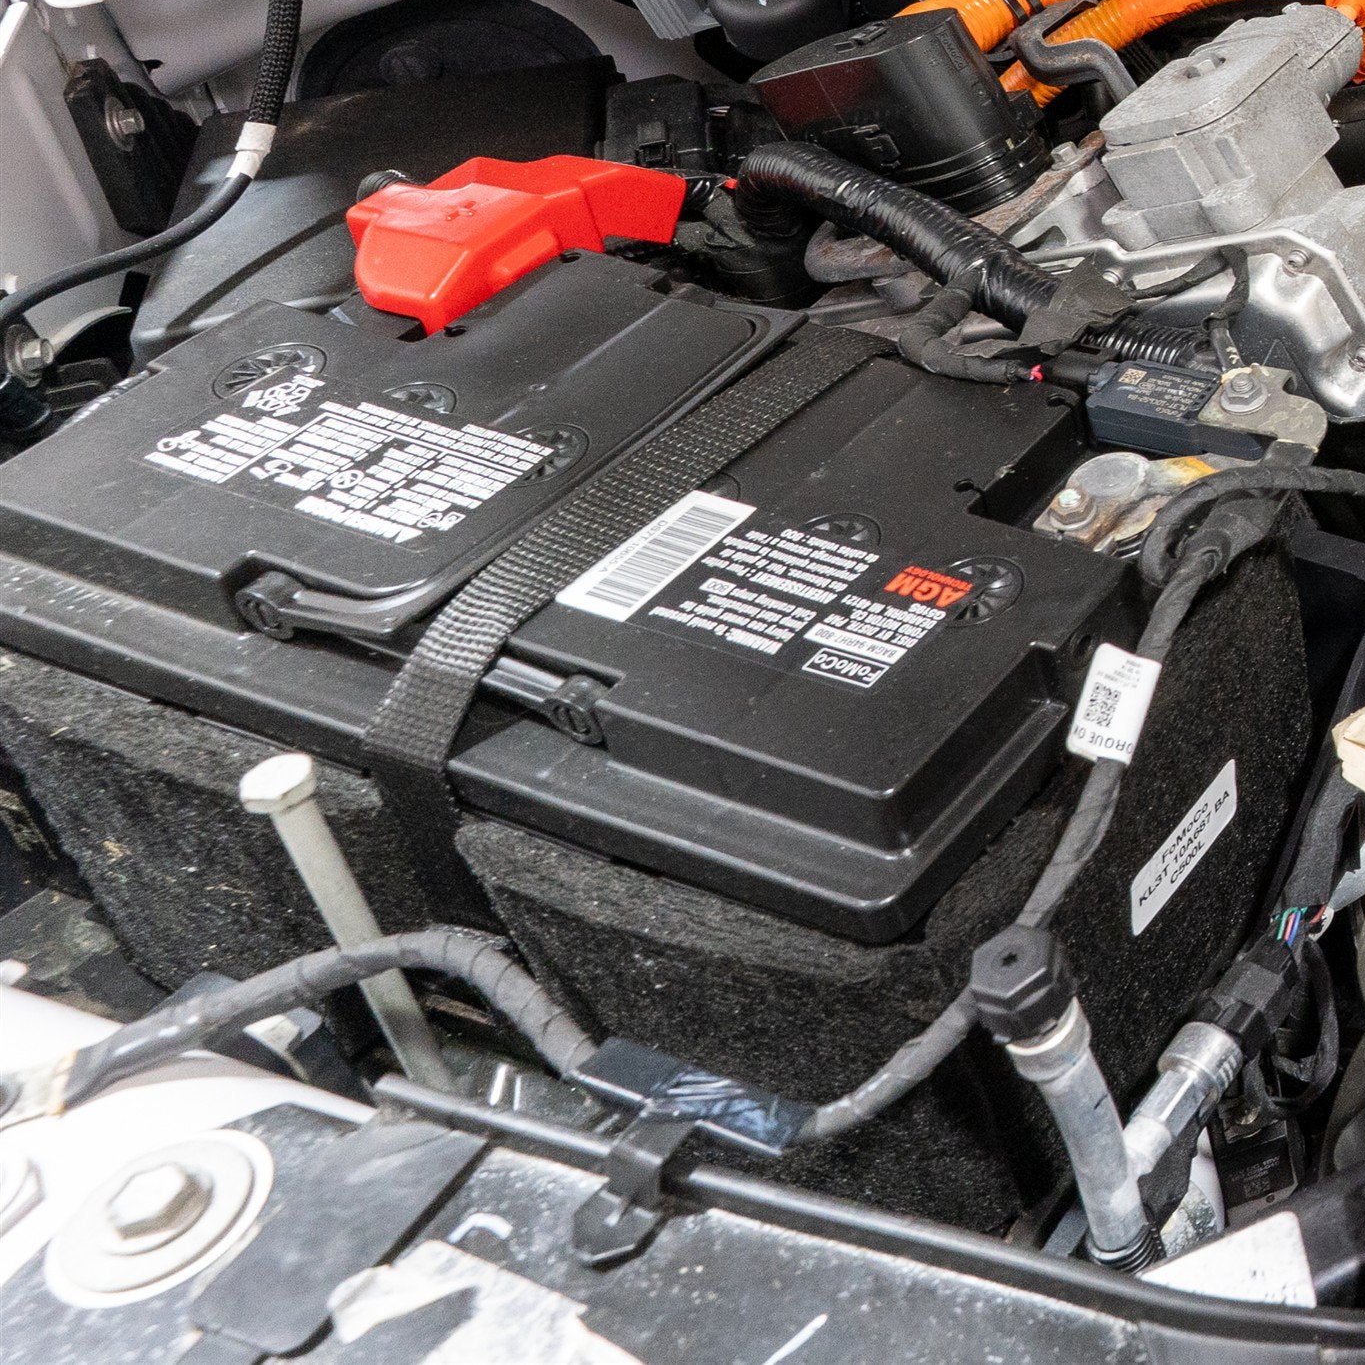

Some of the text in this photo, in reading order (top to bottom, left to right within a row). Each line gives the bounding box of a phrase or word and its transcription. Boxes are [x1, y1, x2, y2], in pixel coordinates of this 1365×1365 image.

[902, 565, 974, 590] TECHNOLOGY
[881, 572, 967, 609] AGM
[687, 616, 717, 630] avoid
[789, 607, 817, 621] Cold
[822, 613, 849, 626] PAR
[846, 608, 928, 637] FORD MOTOR CO.
[711, 624, 729, 635] To
[720, 627, 785, 654] WARNING:
[889, 633, 918, 647] DIST.
[810, 653, 882, 681] FoMoCo
[1214, 790, 1230, 812] BA
[1161, 802, 1209, 864] FoMoCo
[1170, 840, 1205, 885] C500L
